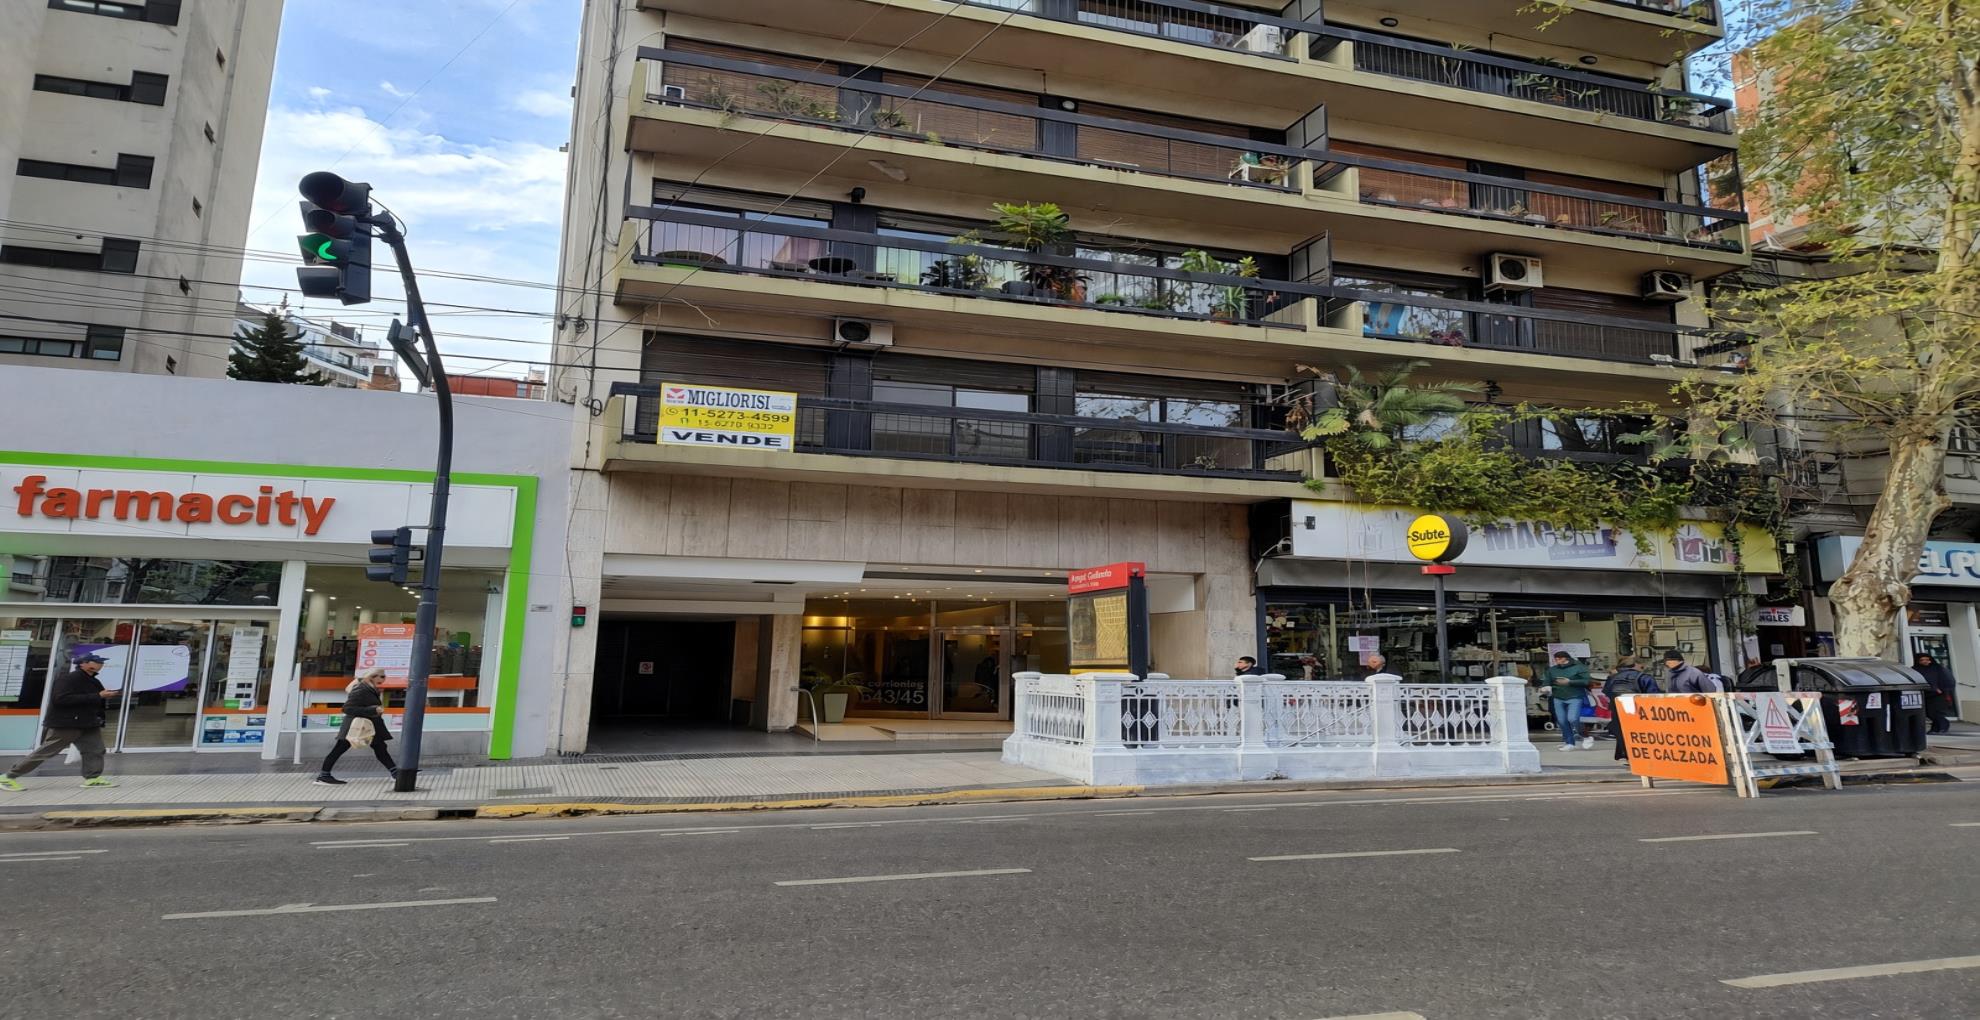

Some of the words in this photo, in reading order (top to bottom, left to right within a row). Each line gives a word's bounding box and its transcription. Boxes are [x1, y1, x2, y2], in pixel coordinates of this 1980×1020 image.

[687, 389, 771, 410] MIGLIORISI
[682, 408, 790, 423] 11-5273-4599
[671, 430, 782, 447] VENDE
[13, 475, 336, 536] farmacity
[1411, 529, 1445, 542] Subte
[1638, 706, 1650, 721] A
[1651, 706, 1695, 723] 100m.
[1630, 731, 1712, 748] REDUCCION
[1631, 747, 1651, 760] DE
[1653, 747, 1718, 765] CALZADA
